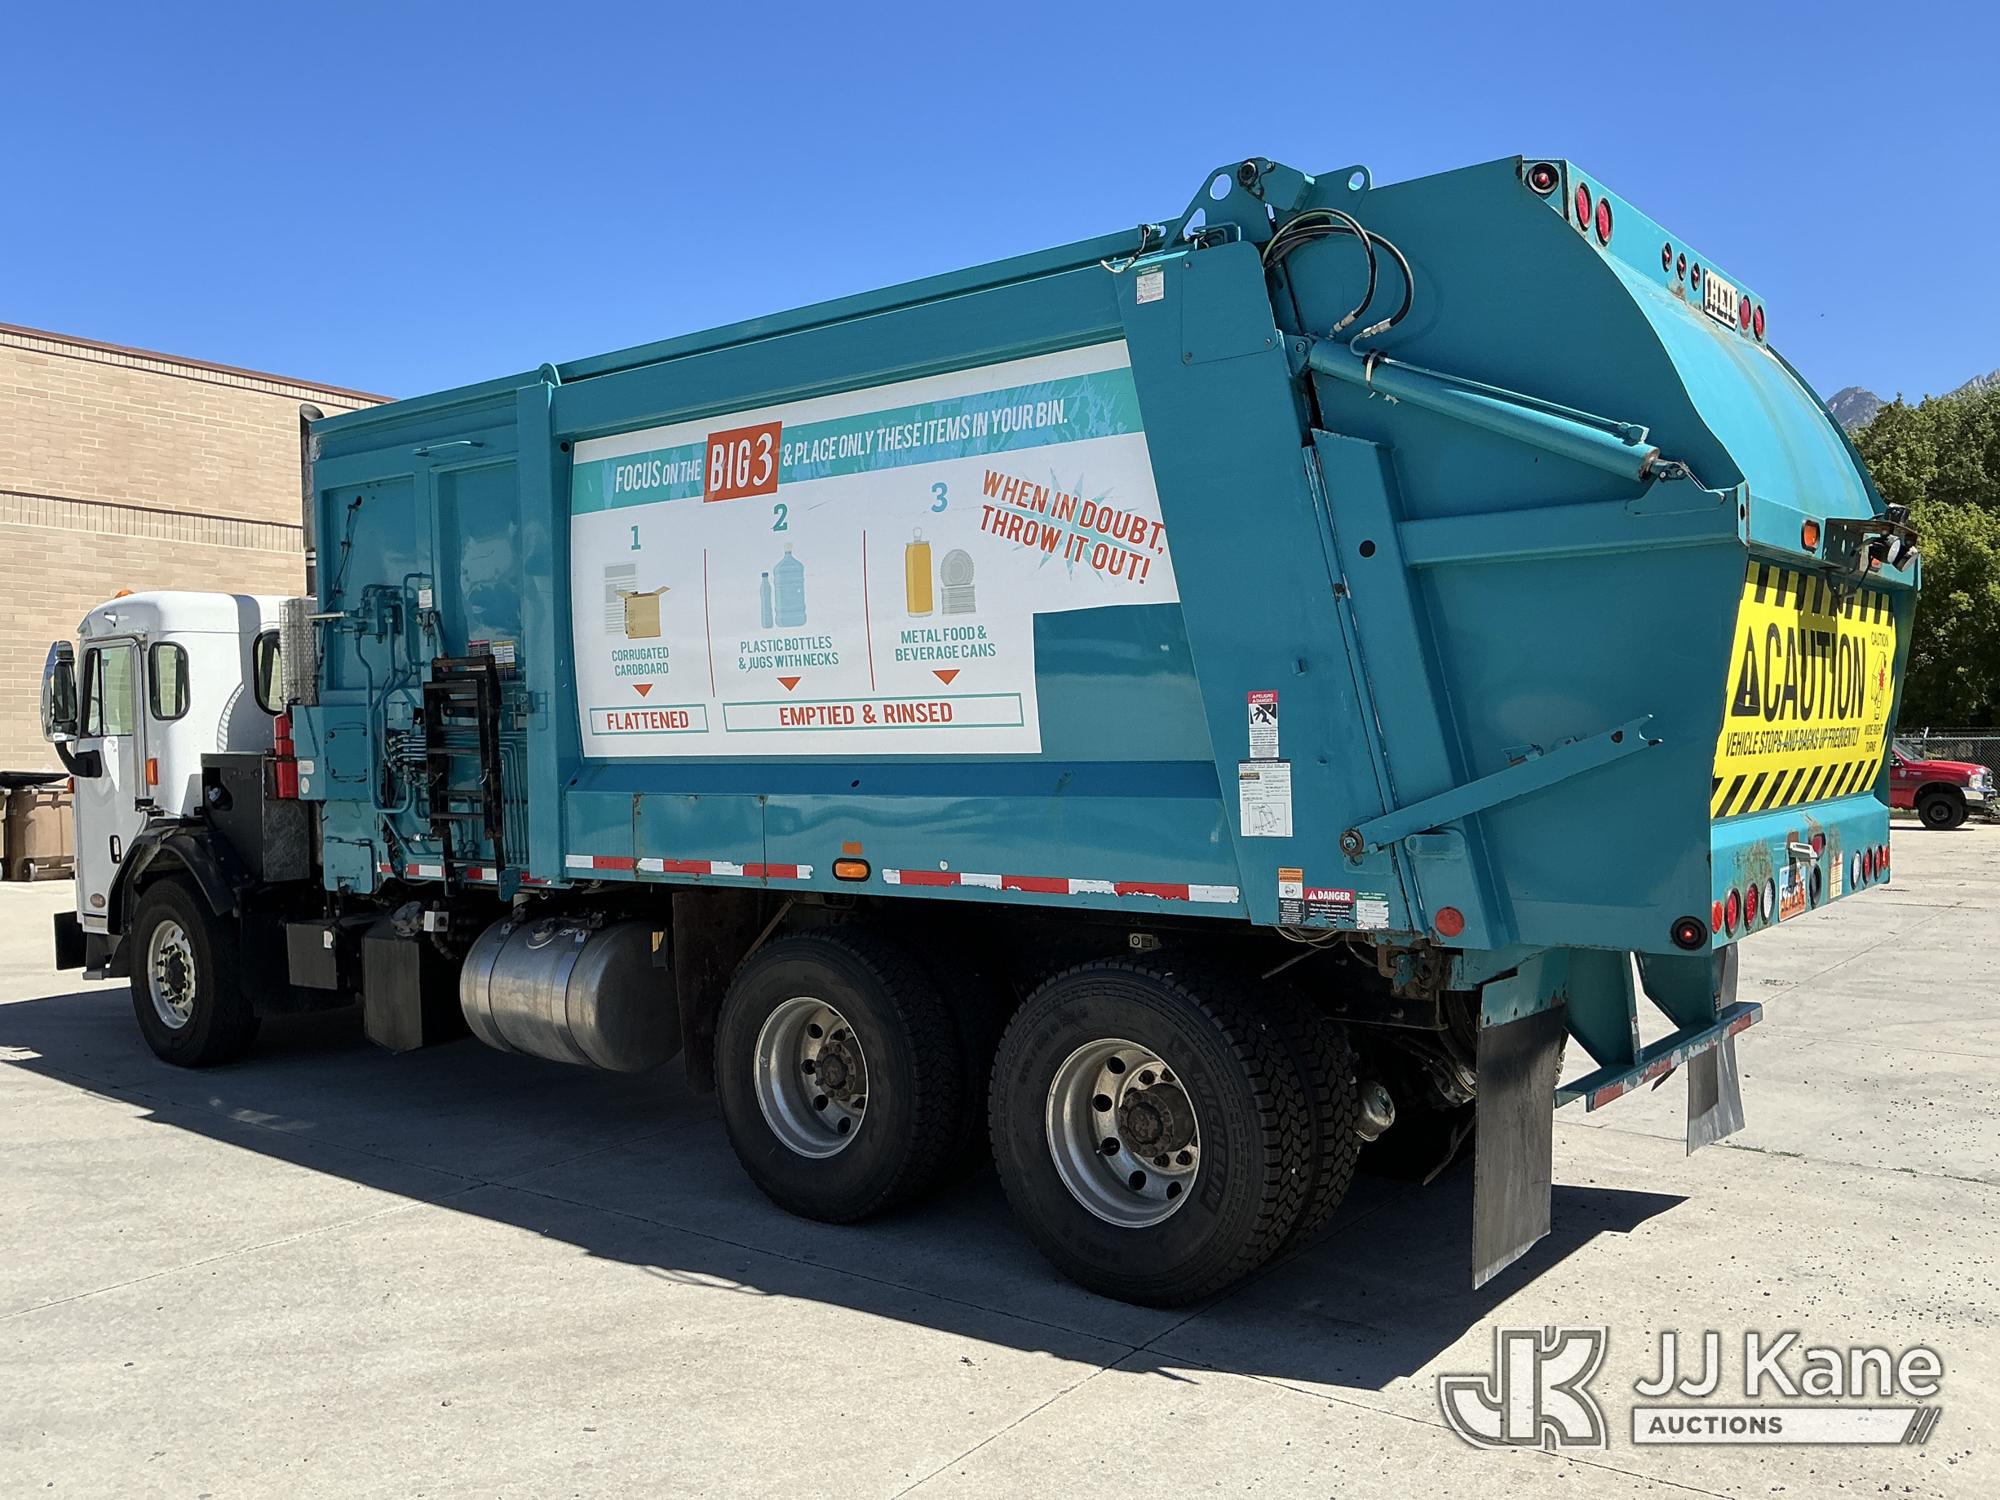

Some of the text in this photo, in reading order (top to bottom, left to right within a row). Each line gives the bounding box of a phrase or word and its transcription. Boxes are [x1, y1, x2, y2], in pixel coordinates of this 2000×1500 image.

[615, 398, 1068, 493] FOCUS ON THE BIG 3 & PLACE ONLY THESE ITEMS IN YOUR BIN.
[931, 482, 948, 513] 3
[773, 504, 788, 532] 2
[983, 469, 1165, 555] WHEN IN DOUBT,
[631, 525, 641, 551] 1
[981, 505, 1151, 585] THROW IT OUT!
[740, 636, 832, 654] PLASTIC BOTTLES
[900, 625, 987, 645] METAL FOOD &
[612, 647, 669, 662] CORRUGATED
[738, 652, 839, 670] & JUGS WITH NECKS
[895, 643, 997, 662] BEVERAGE CANS
[615, 662, 669, 677] CARDBOARD
[1763, 622, 1866, 723] CAUTION
[607, 711, 689, 730] FLATTENED
[779, 702, 953, 726] EMPTIED & RINSED
[1726, 730, 1760, 758] VEHICLE
[1759, 729, 1783, 755] STOPS
[1317, 890, 1351, 901] DANGER
